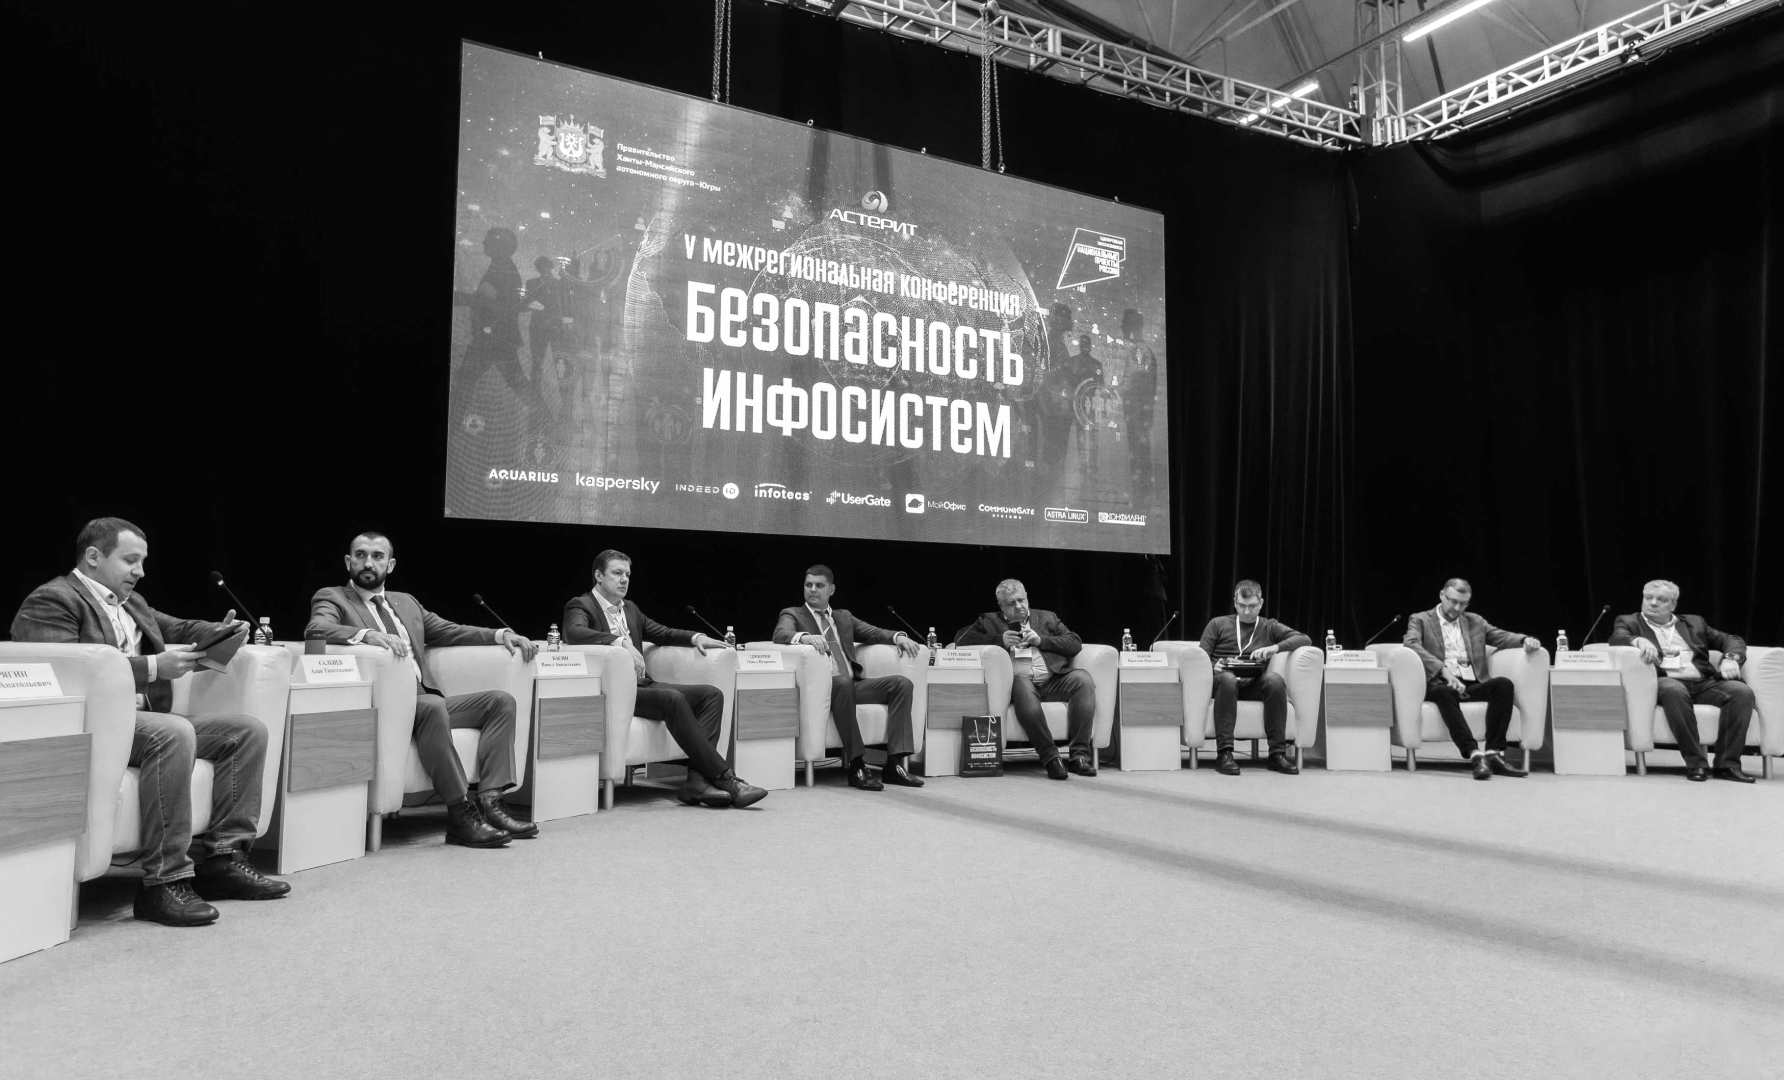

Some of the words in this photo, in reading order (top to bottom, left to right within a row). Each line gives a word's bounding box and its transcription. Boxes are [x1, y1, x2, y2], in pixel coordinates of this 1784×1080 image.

[617, 143, 675, 162] Правительство
[616, 153, 695, 175] Ханты-Мансийского
[616, 165, 667, 180] автономного
[684, 234, 695, 259] V
[488, 468, 559, 483] AQUARIUS
[575, 472, 660, 494] kaspersky
[675, 484, 719, 494] INDEED
[754, 484, 810, 501] infotecs
[841, 493, 891, 507] UserGate
[927, 500, 966, 511] МойОфис
[1047, 511, 1067, 519] ASTRA
[1068, 512, 1086, 521] LINUX
